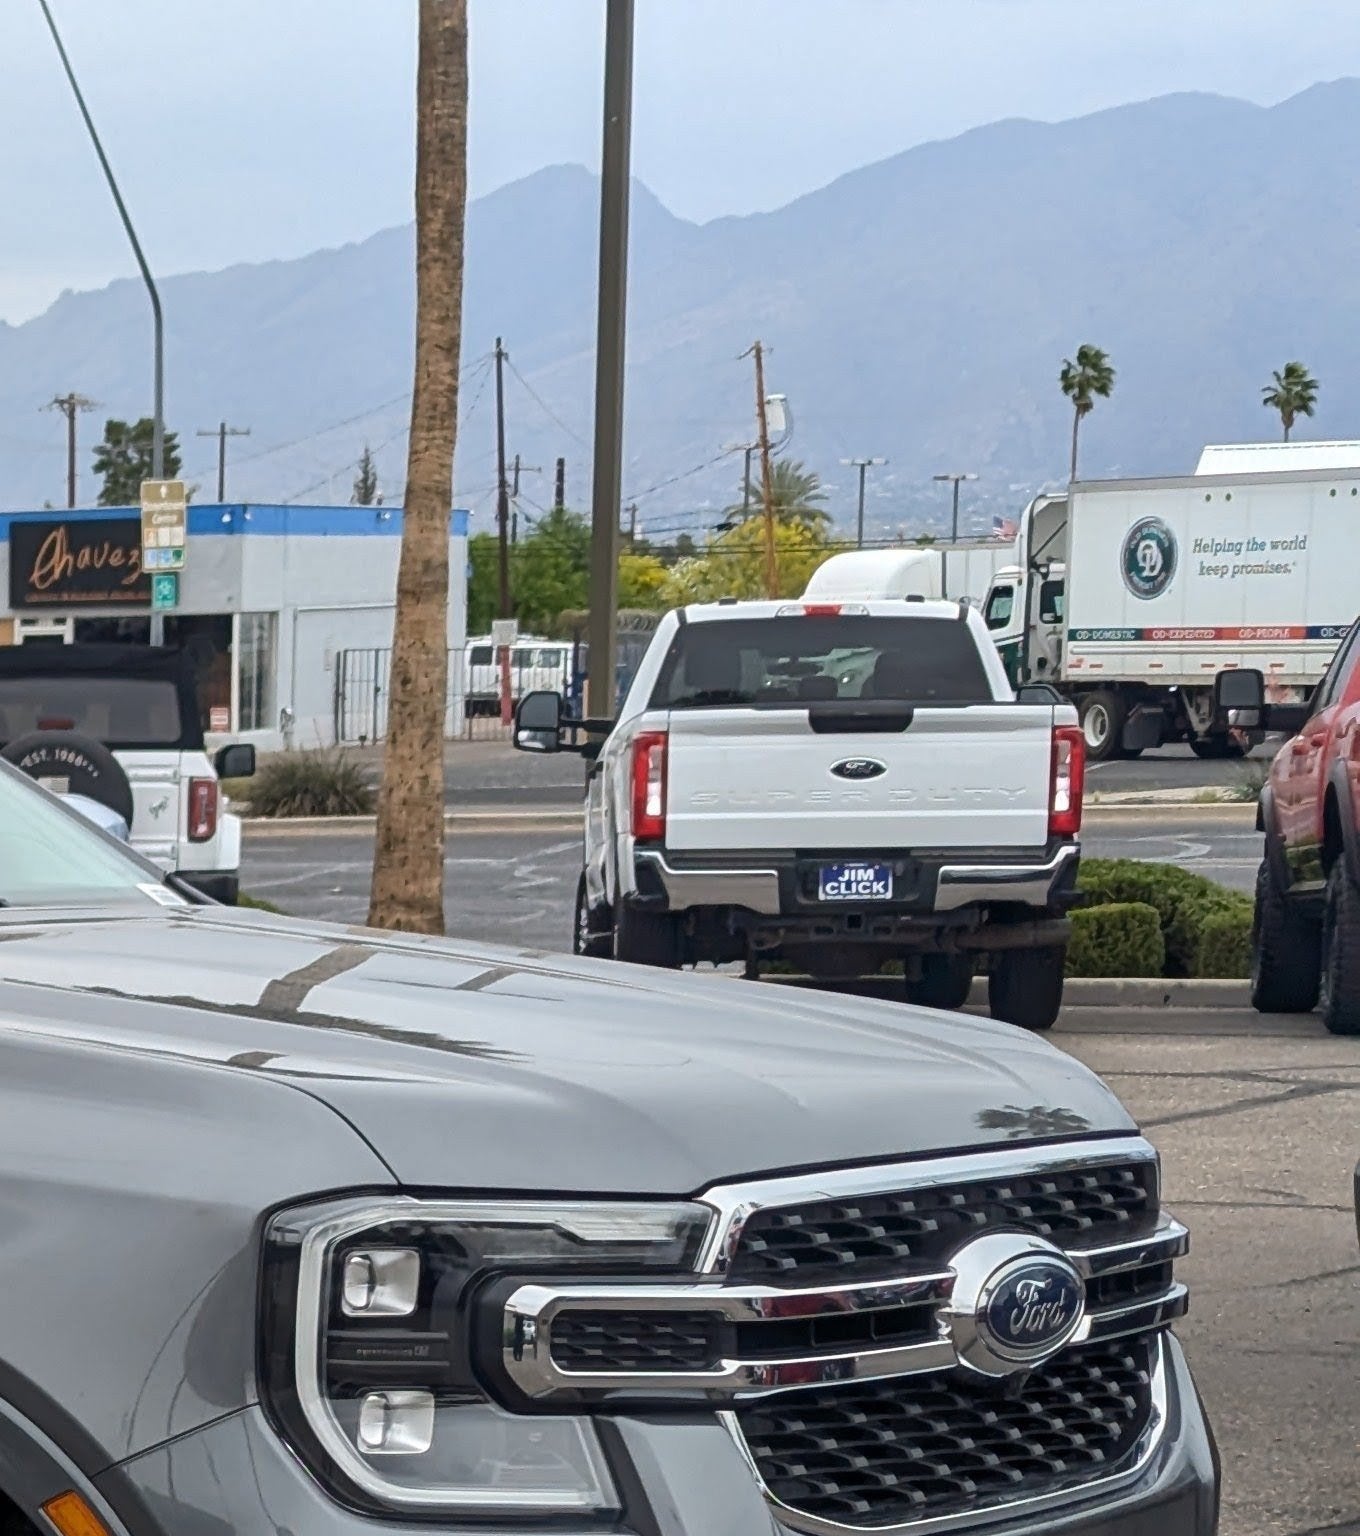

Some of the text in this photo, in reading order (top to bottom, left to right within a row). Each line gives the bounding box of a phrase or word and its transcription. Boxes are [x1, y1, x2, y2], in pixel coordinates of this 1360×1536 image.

[1192, 534, 1308, 556] Helping the world
[1198, 560, 1229, 578] keep
[838, 868, 875, 881] JIM
[825, 881, 886, 895] CLICK
[1009, 1277, 1067, 1336] Ford
